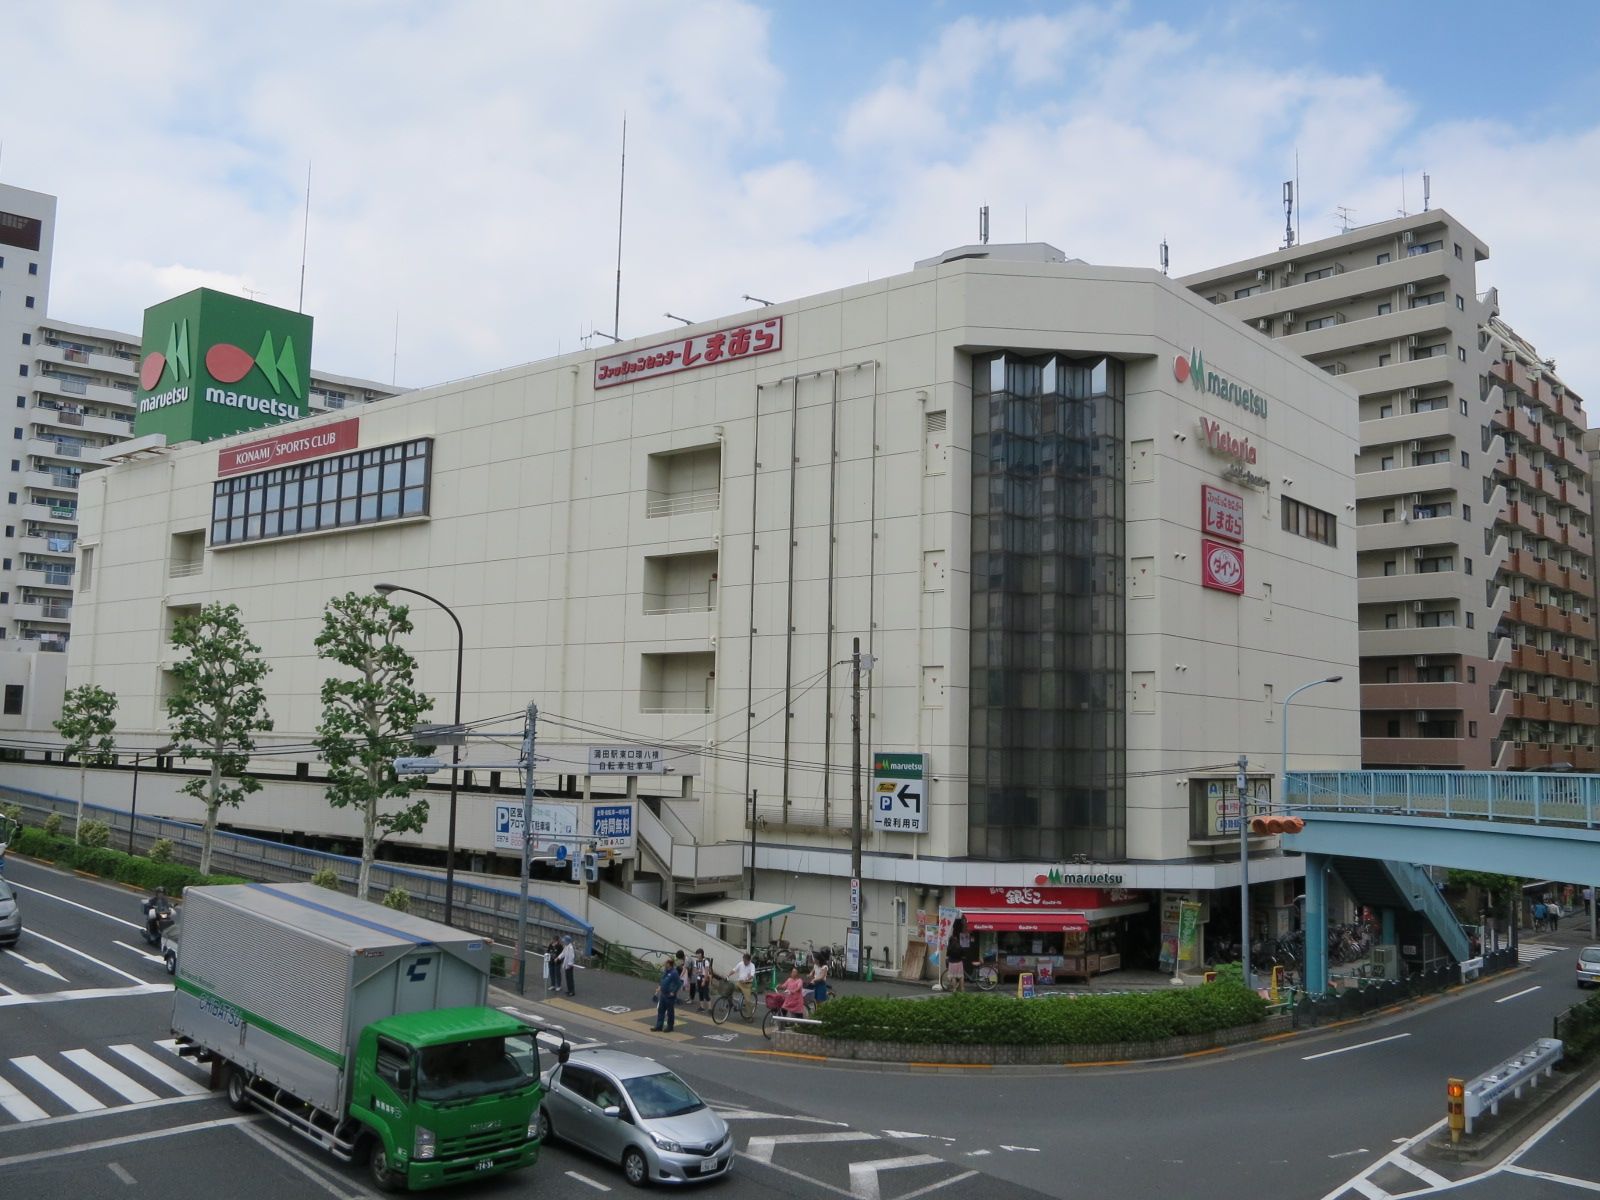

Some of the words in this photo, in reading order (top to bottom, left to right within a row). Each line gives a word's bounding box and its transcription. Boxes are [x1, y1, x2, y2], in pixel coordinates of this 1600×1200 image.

[140, 386, 189, 414] maruetsu
[205, 387, 300, 420] maruetsu
[1207, 371, 1268, 420] maruetsu
[236, 446, 270, 465] KONAMI
[275, 437, 310, 457] SPORTS
[311, 432, 336, 449] CLUB
[1200, 416, 1257, 465] Victoria
[1208, 507, 1242, 536] しまむら
[1213, 557, 1240, 577] ダイソー
[890, 762, 922, 770] maruetsu
[510, 807, 523, 818] 区営
[875, 817, 920, 829] 一般利用可
[595, 817, 630, 835] 2時間無料
[1064, 873, 1123, 885] maruetsu
